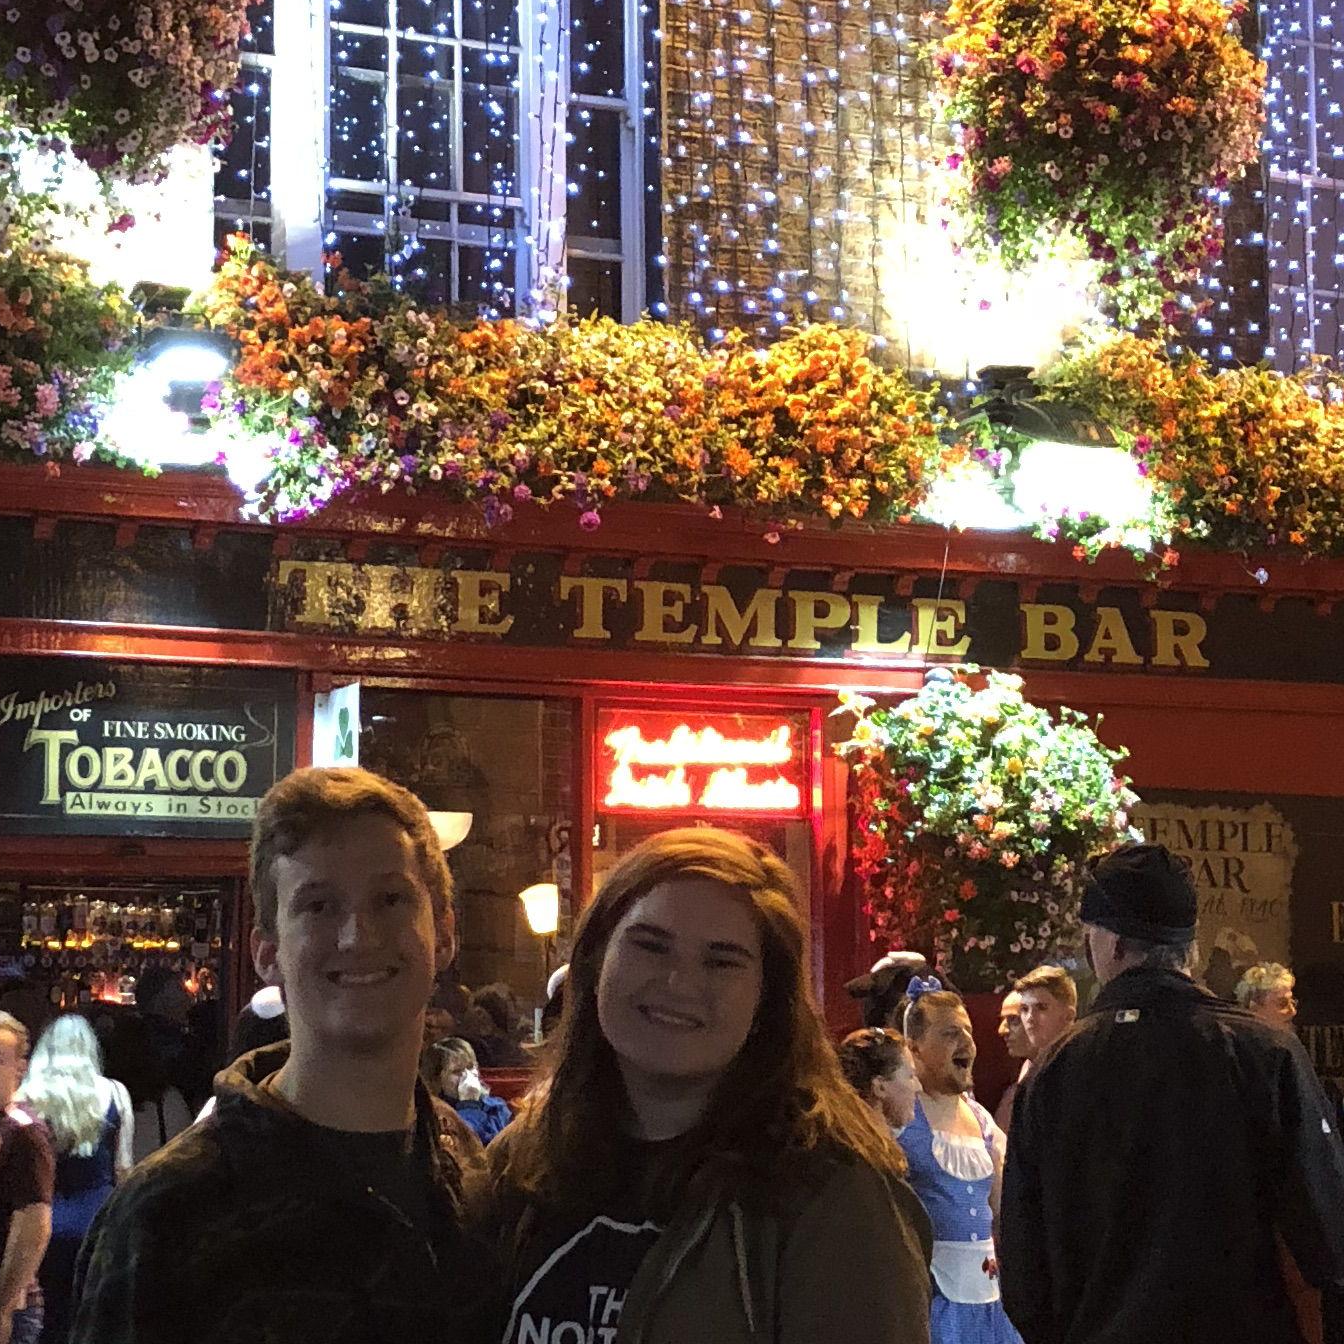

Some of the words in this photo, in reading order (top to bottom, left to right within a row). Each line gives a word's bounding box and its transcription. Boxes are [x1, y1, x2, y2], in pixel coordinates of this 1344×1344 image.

[277, 560, 514, 636] THE
[560, 576, 973, 657] TEMPLE
[1020, 604, 1211, 668] BAR
[69, 708, 92, 723] OF
[102, 720, 150, 740] FINE
[154, 721, 248, 743] SMOKING
[23, 728, 248, 805] TOBACCO
[69, 793, 154, 815] Always
[167, 797, 187, 814] in
[589, 1285, 630, 1326] TH
